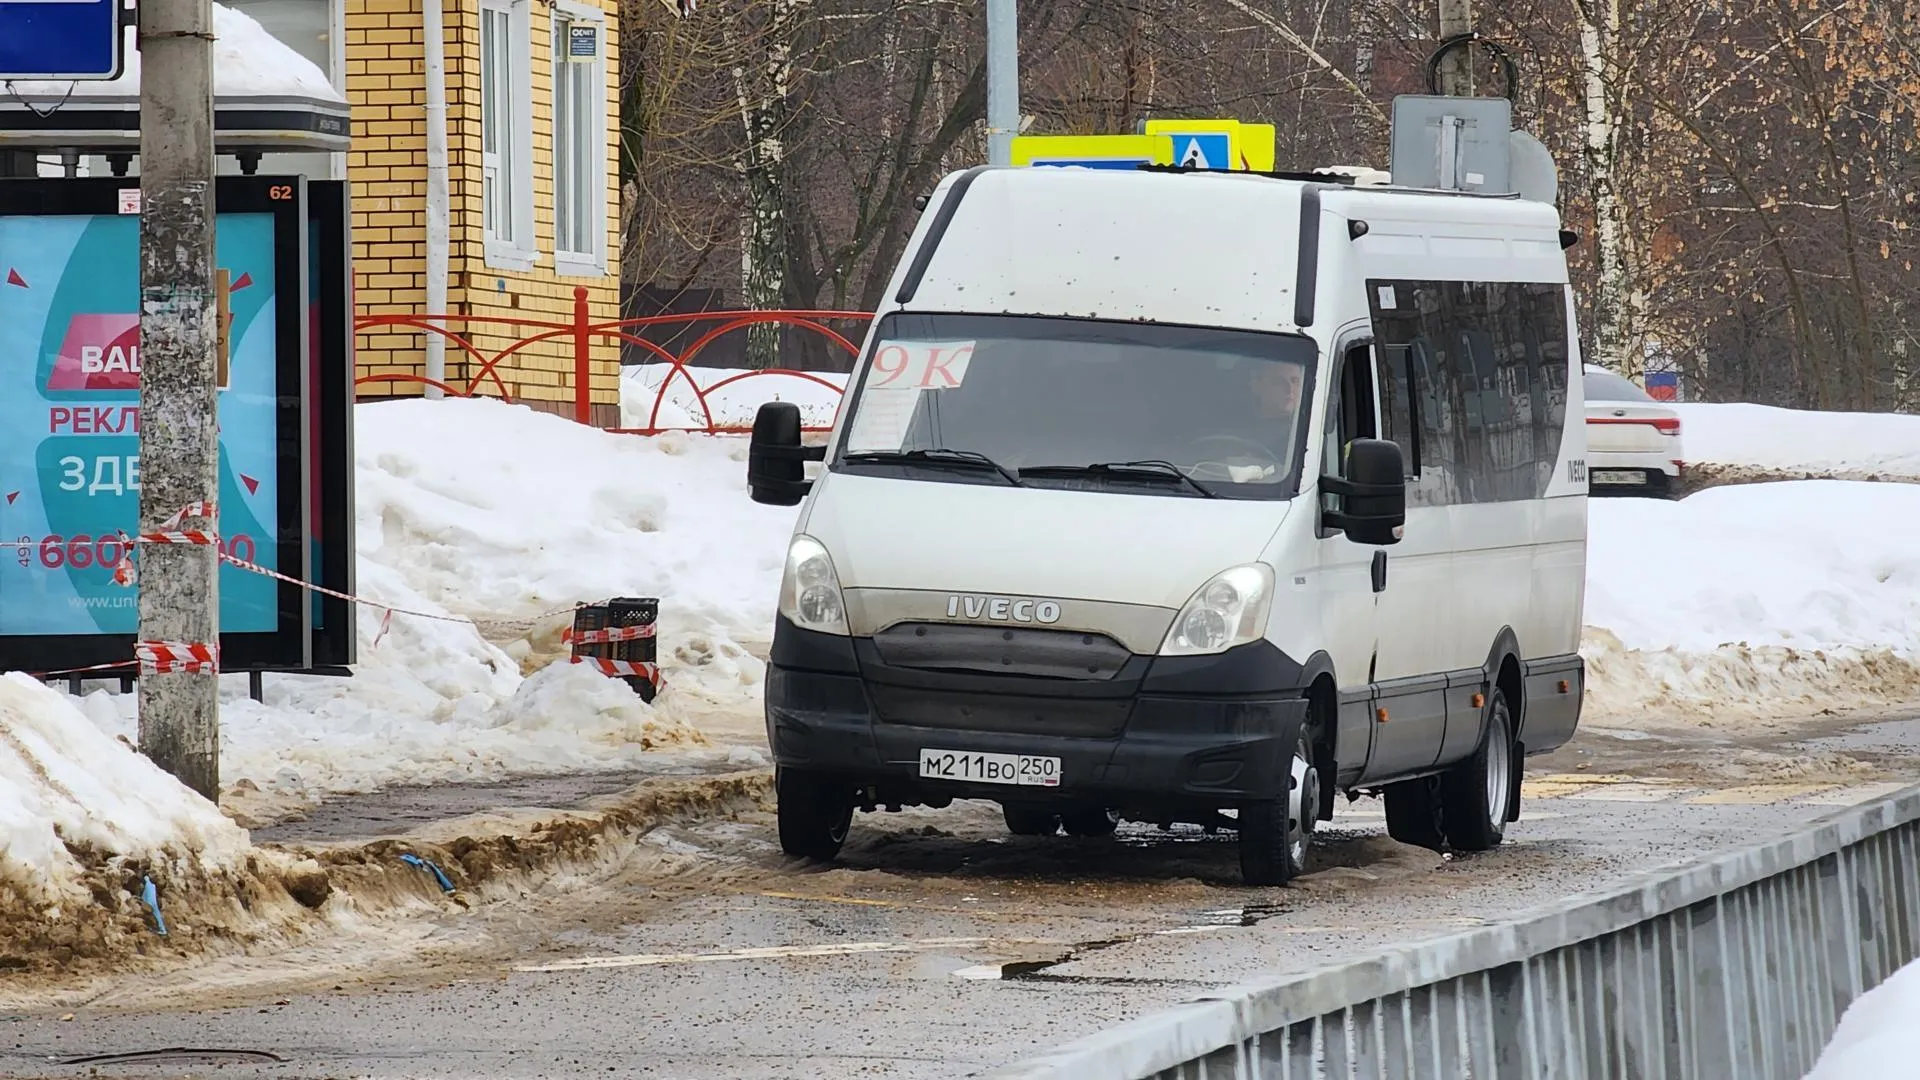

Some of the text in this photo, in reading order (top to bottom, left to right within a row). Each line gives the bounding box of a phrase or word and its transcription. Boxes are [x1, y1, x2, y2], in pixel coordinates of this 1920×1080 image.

[270, 185, 292, 200] 62
[81, 345, 141, 374] ВА
[58, 455, 140, 496] ЗДЕ
[1567, 459, 1586, 484] IVECO
[17, 535, 31, 568] 495
[67, 594, 139, 609] www.uni
[947, 595, 1061, 624] IVECO
[1020, 758, 1054, 776] 250
